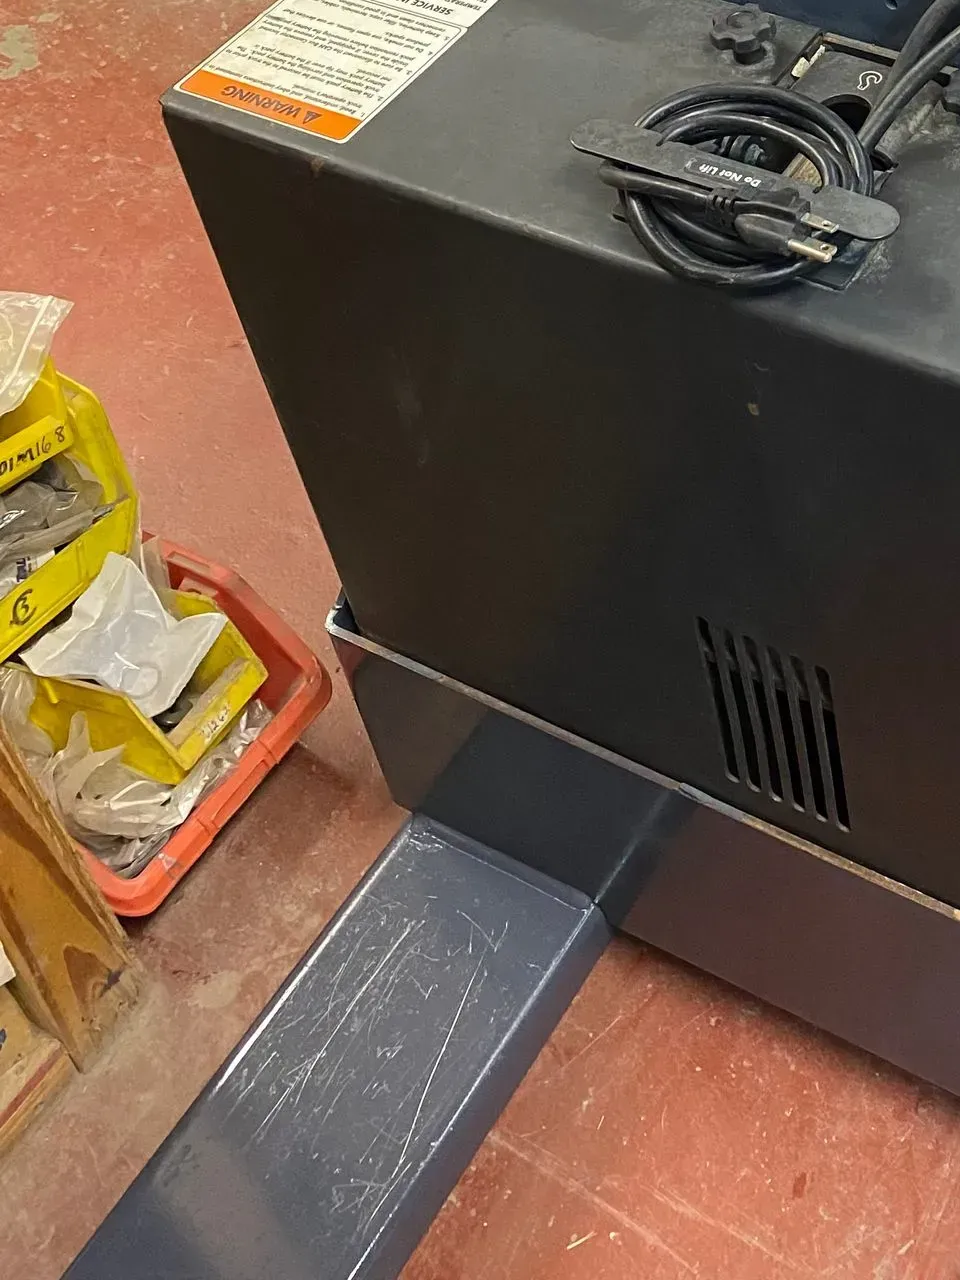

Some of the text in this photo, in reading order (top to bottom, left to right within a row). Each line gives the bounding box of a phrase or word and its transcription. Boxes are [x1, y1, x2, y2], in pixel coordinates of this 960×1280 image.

[217, 84, 305, 118] WARNING
[698, 163, 762, 188] Do Not Lift
